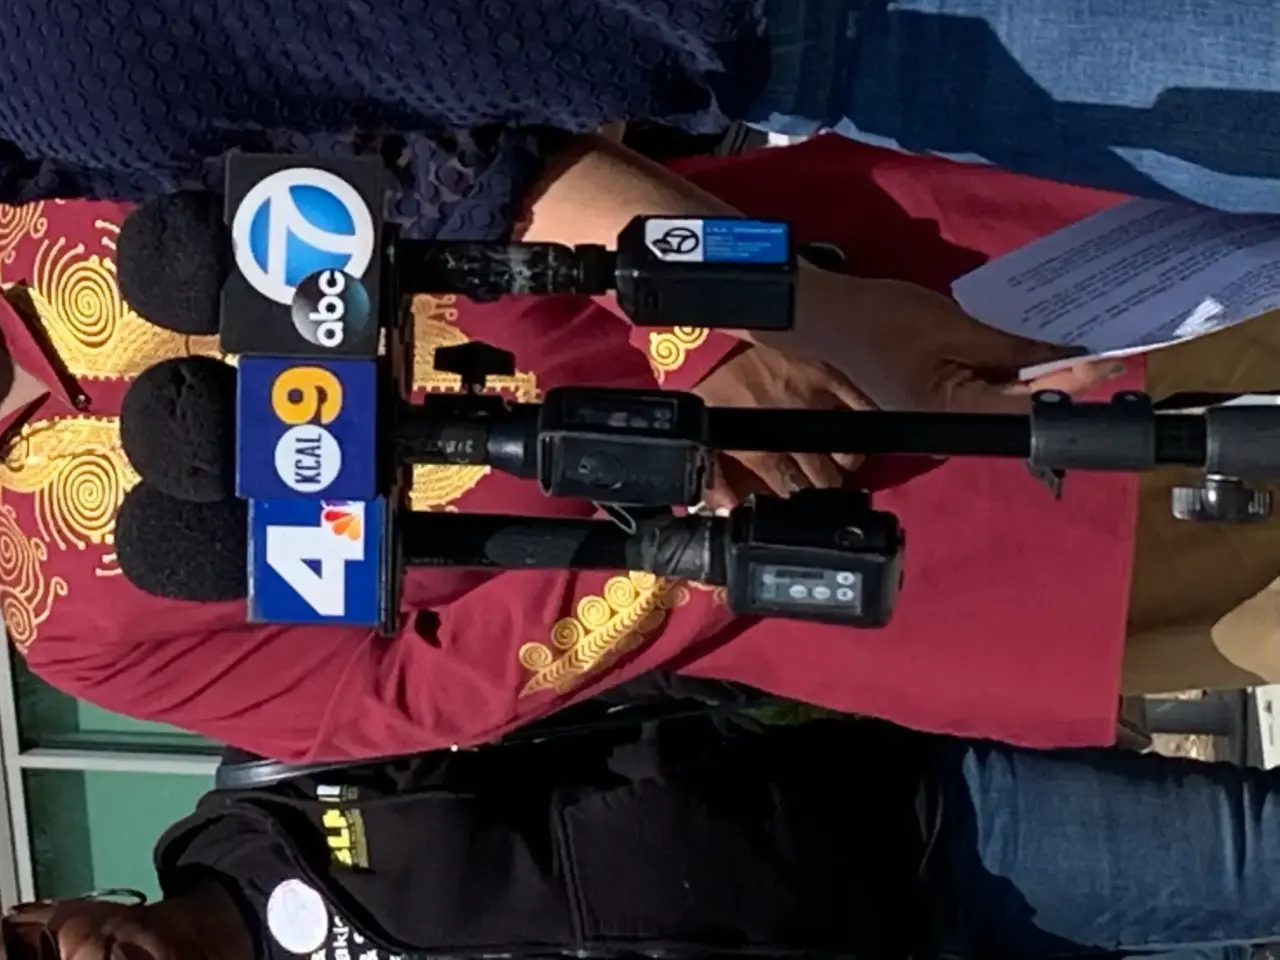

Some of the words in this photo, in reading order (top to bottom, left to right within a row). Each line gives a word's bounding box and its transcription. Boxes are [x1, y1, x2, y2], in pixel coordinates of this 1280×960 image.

[250, 175, 365, 295] 7
[308, 269, 346, 348] abc
[271, 366, 344, 426] 9
[294, 433, 323, 485] KCAL
[266, 524, 365, 617] 4
